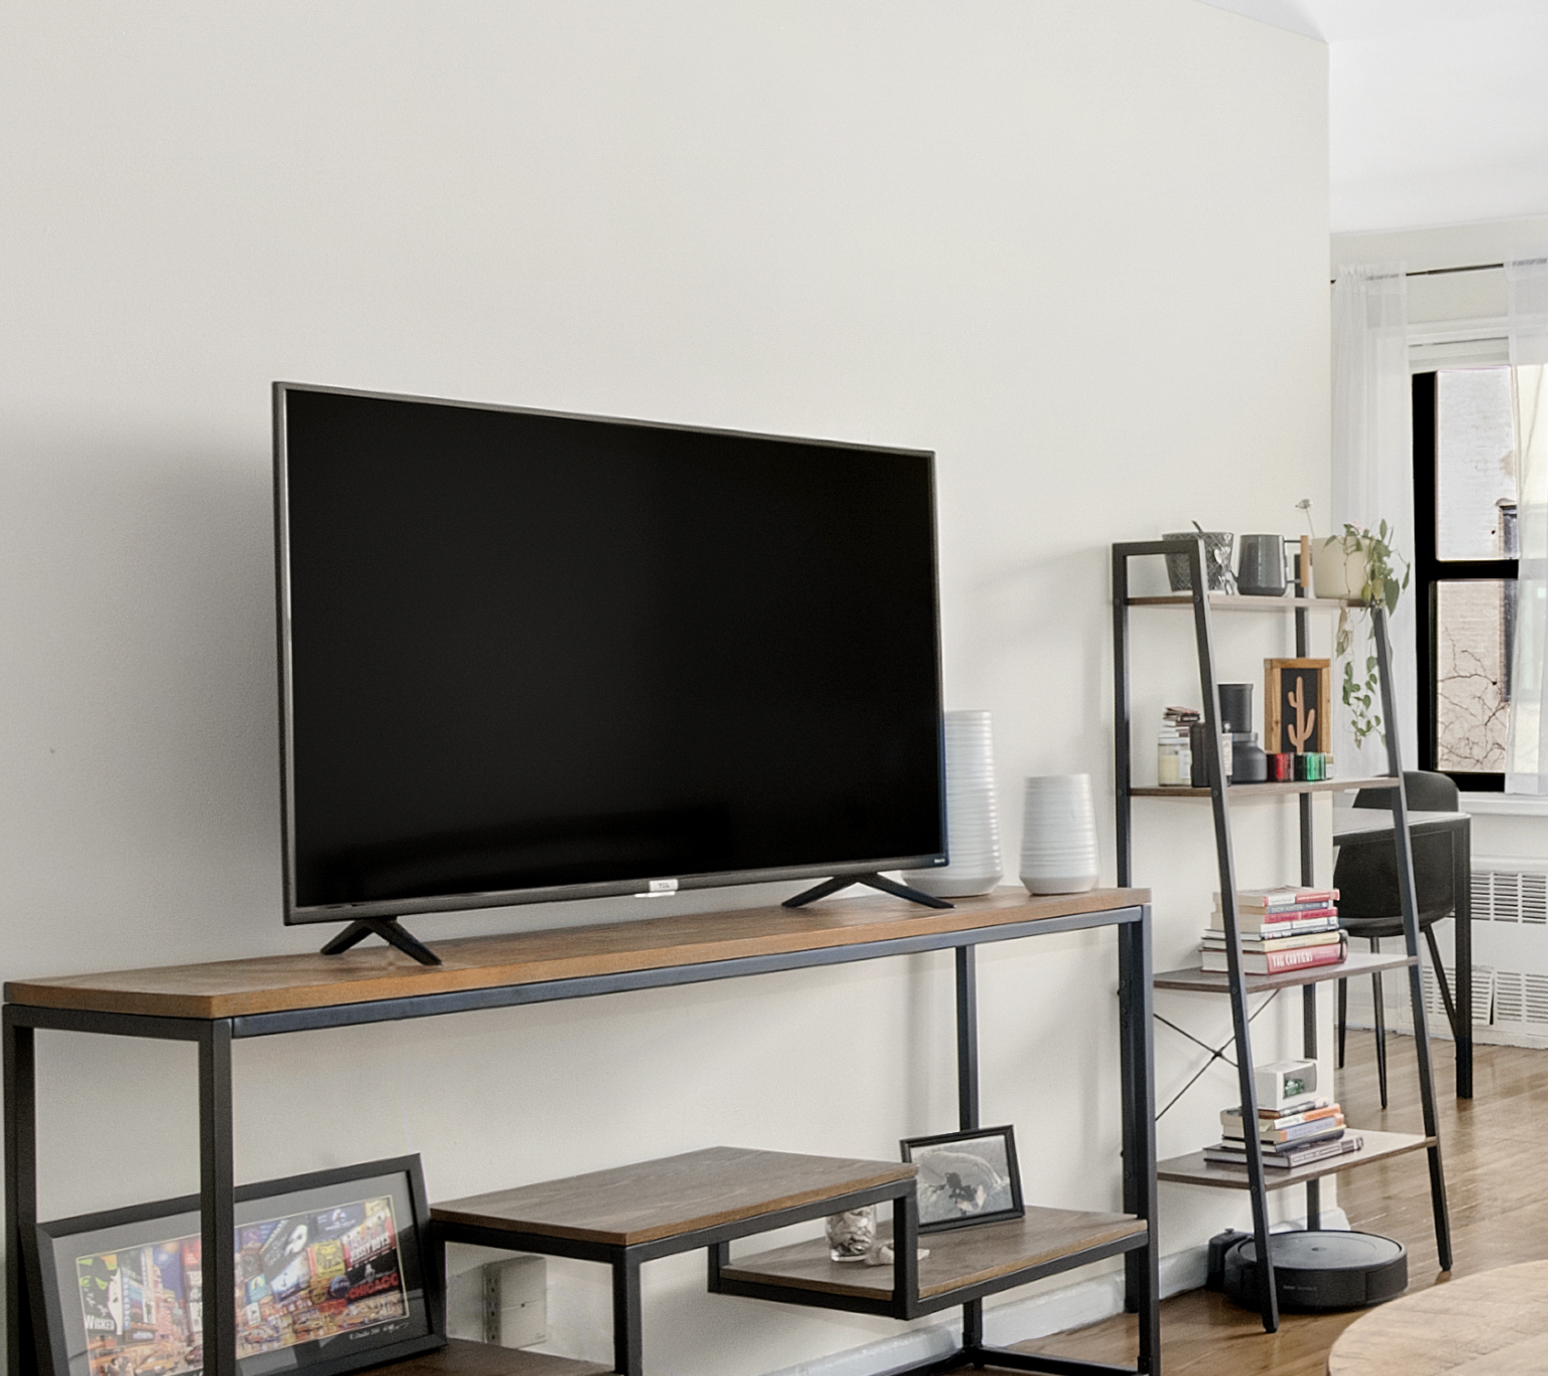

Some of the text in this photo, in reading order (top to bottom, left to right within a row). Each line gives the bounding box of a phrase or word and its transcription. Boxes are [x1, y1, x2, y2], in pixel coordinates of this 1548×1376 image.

[1272, 955, 1285, 968] THE
[1285, 951, 1313, 966] CARTIERS
[349, 1272, 399, 1299] CHICAGO
[85, 1314, 115, 1330] WICKED
